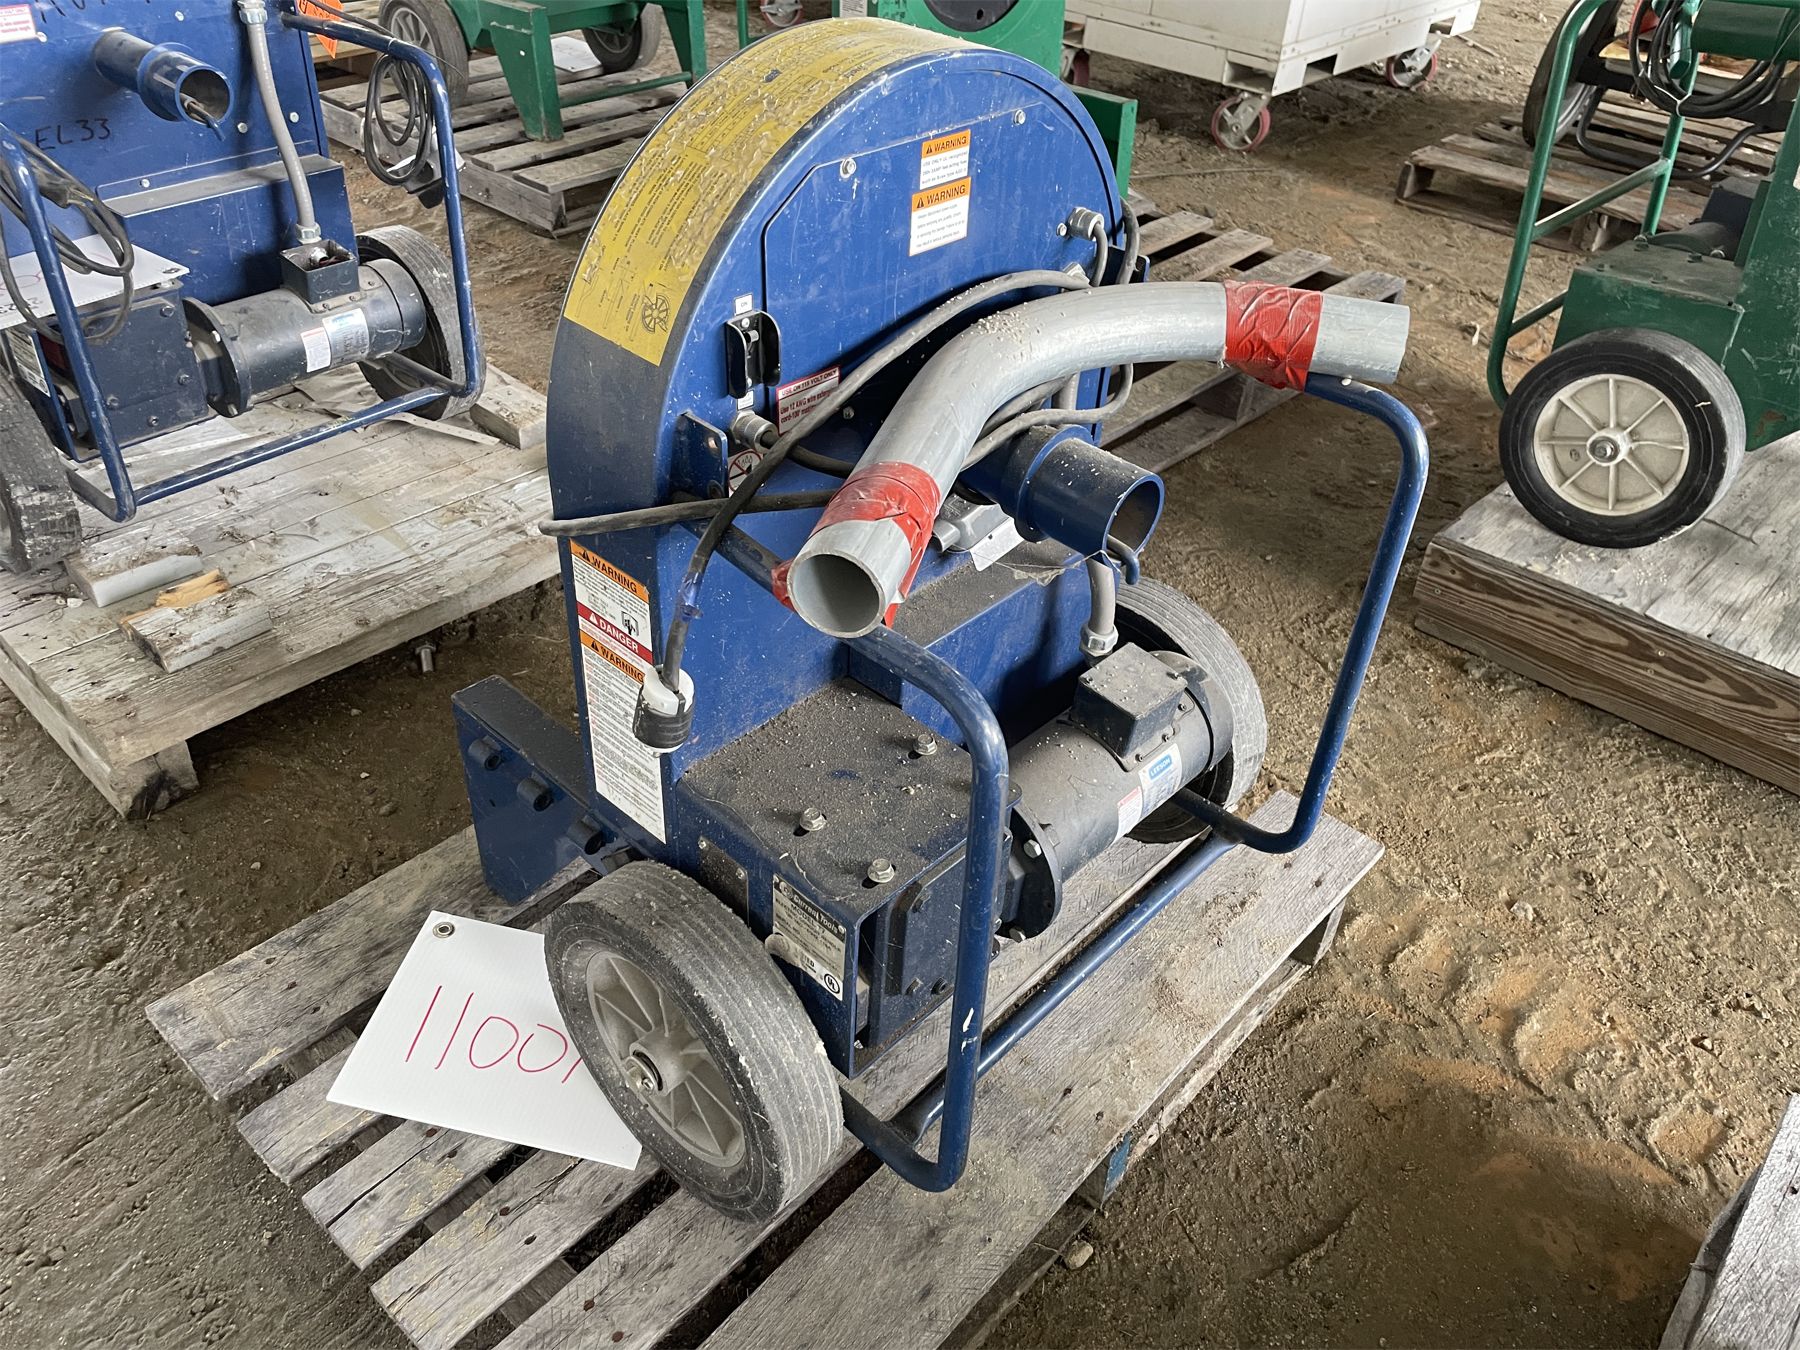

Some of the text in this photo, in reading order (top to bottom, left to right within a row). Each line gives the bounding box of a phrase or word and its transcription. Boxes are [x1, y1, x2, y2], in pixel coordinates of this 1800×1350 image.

[35, 118, 110, 150] EL33
[934, 136, 967, 152] WARNING
[926, 184, 966, 204] WARNING
[810, 376, 824, 386] VOLT
[824, 370, 837, 380] ONLY
[592, 558, 637, 593] WARNING
[600, 618, 639, 653] DANGER
[600, 648, 644, 682] WARNING
[1150, 757, 1171, 776] LEESON
[790, 904, 814, 926] MODEL
[794, 895, 819, 920] Current
[820, 915, 838, 934] Tools
